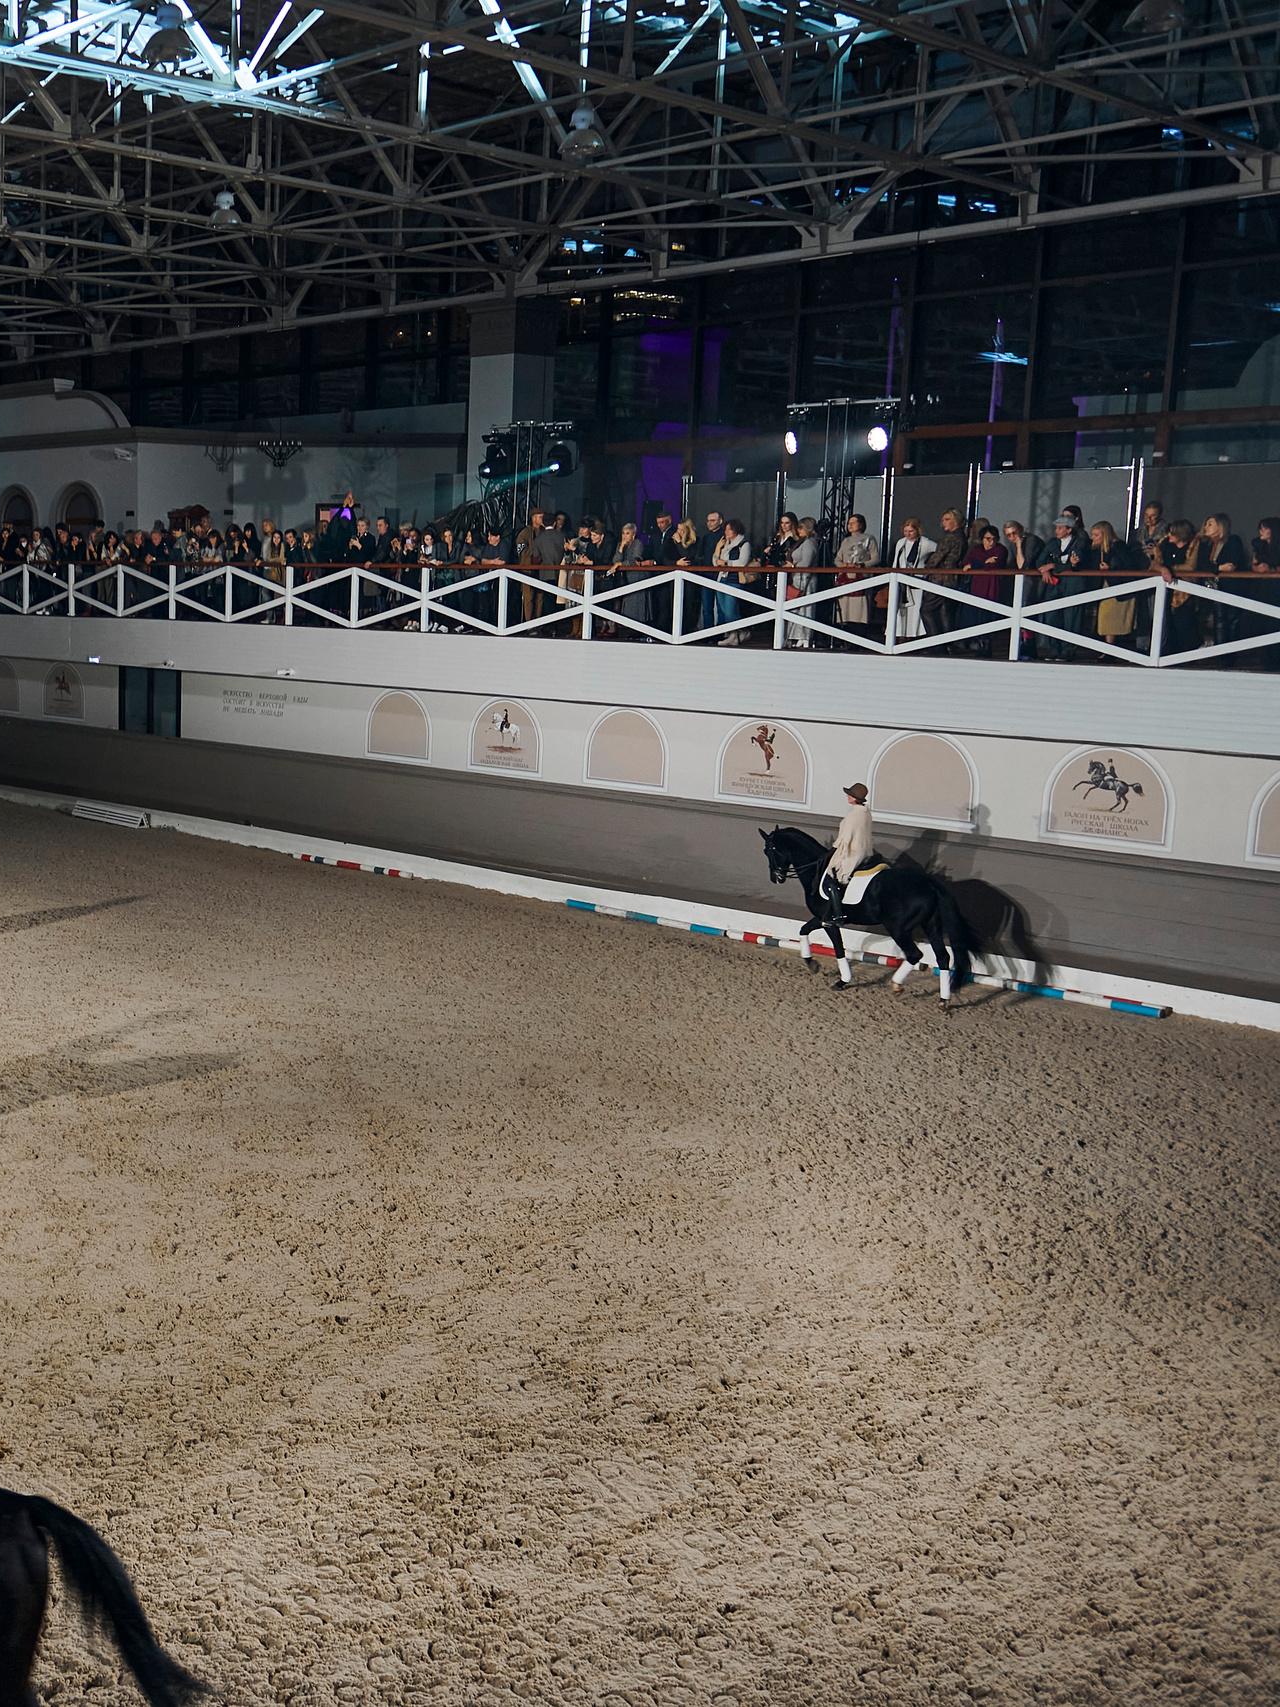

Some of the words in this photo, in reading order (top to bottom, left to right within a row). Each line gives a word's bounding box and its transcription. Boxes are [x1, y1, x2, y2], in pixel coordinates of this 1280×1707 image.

[1064, 811, 1089, 820] ГАЛОП
[1124, 818, 1150, 827] НОГАХ
[1071, 819, 1105, 828] РУССКАЯ
[1109, 822, 1139, 832] ШКОЛА
